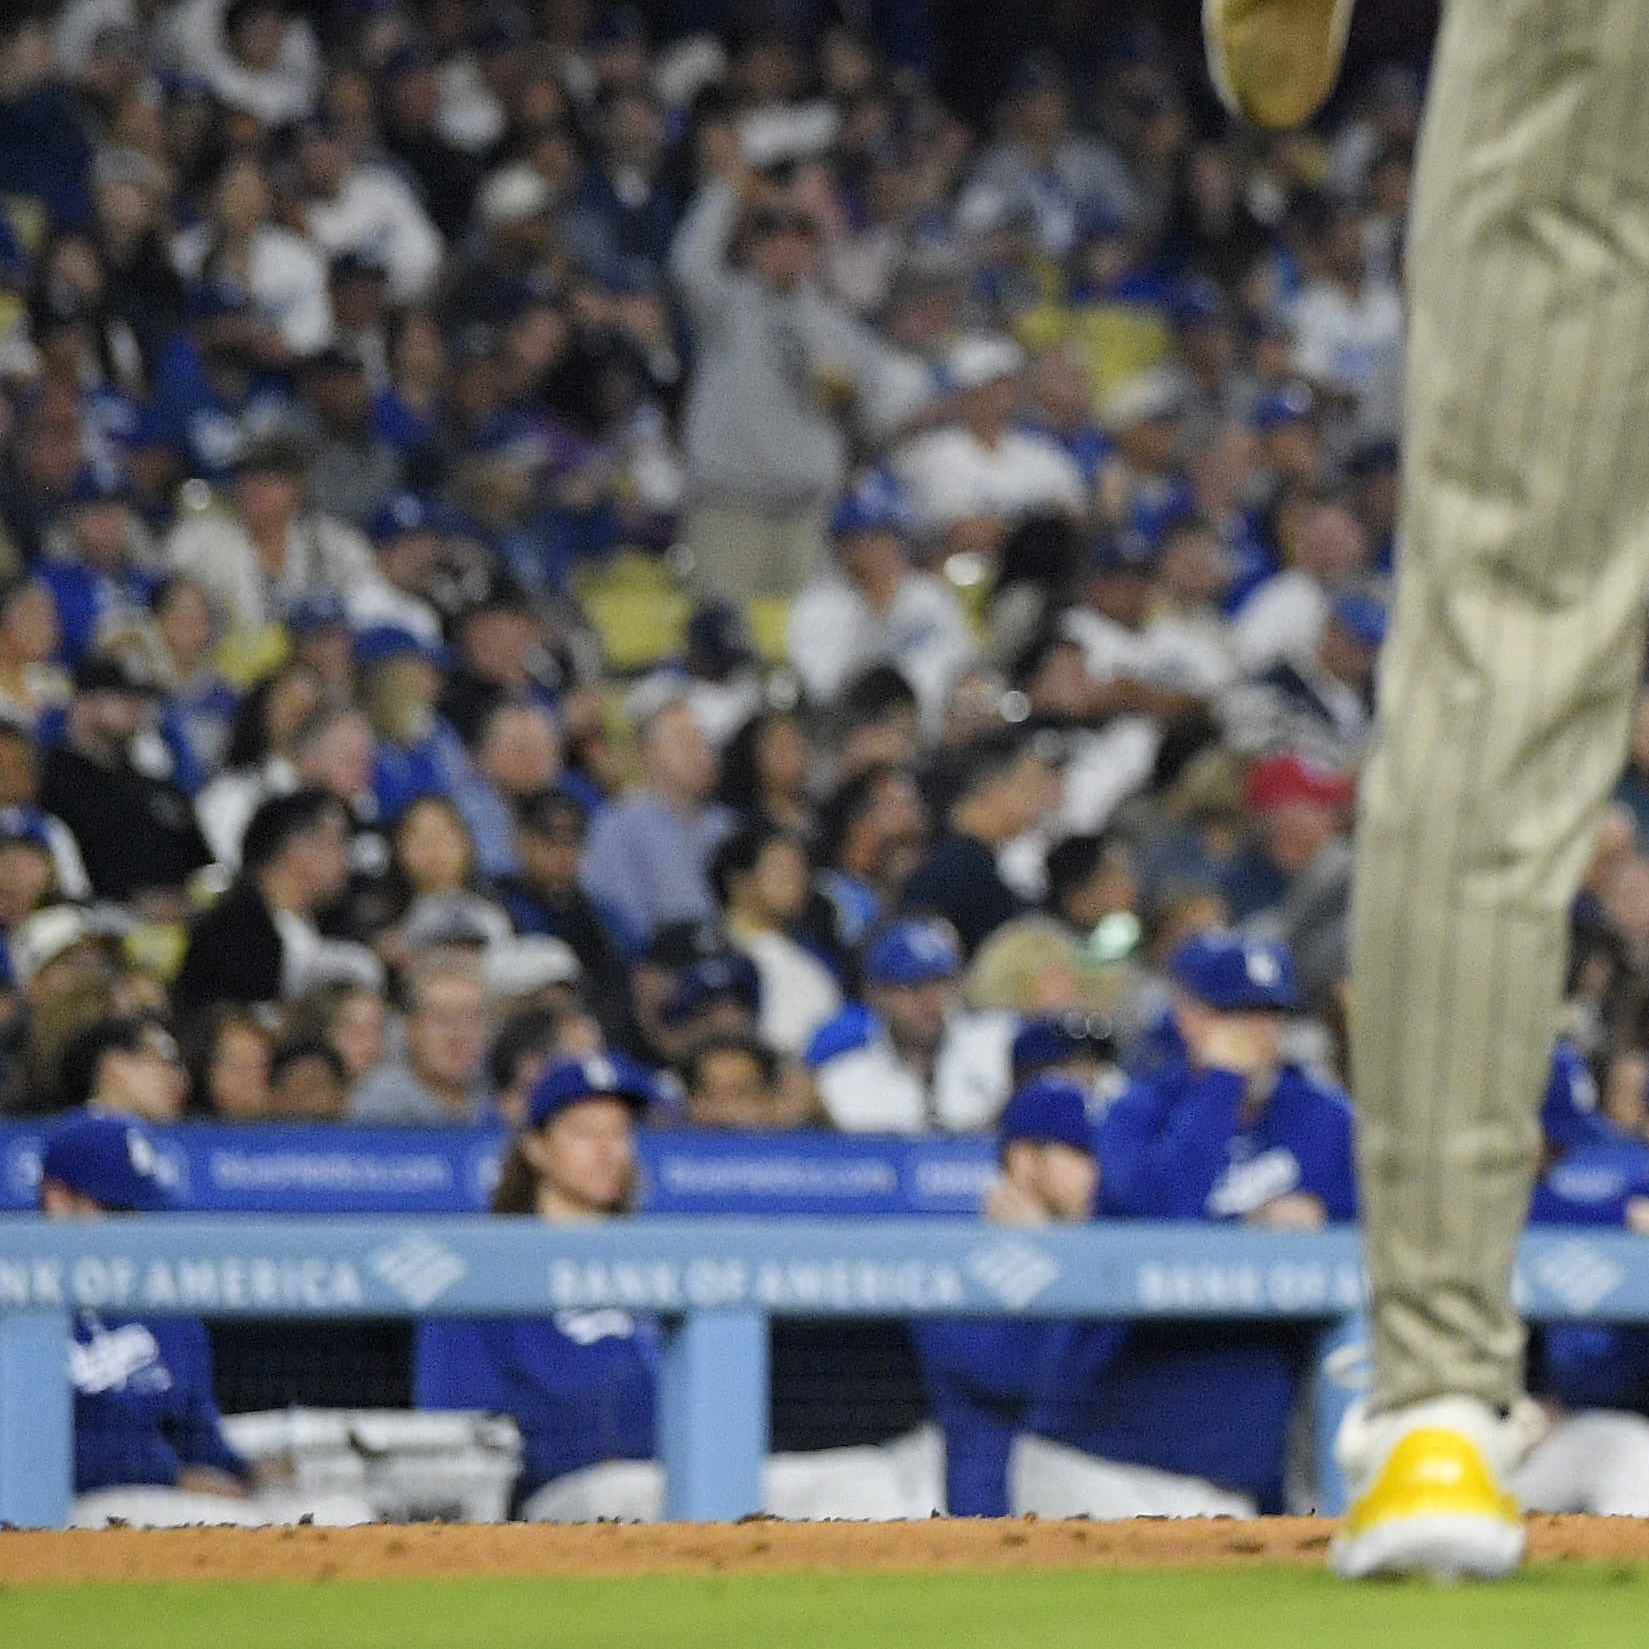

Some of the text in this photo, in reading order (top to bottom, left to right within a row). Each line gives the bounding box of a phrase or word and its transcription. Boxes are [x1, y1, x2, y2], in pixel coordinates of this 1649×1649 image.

[70, 1254, 136, 1306] OF
[146, 1255, 363, 1308] AMERICA
[756, 1259, 966, 1310] AMERICA
